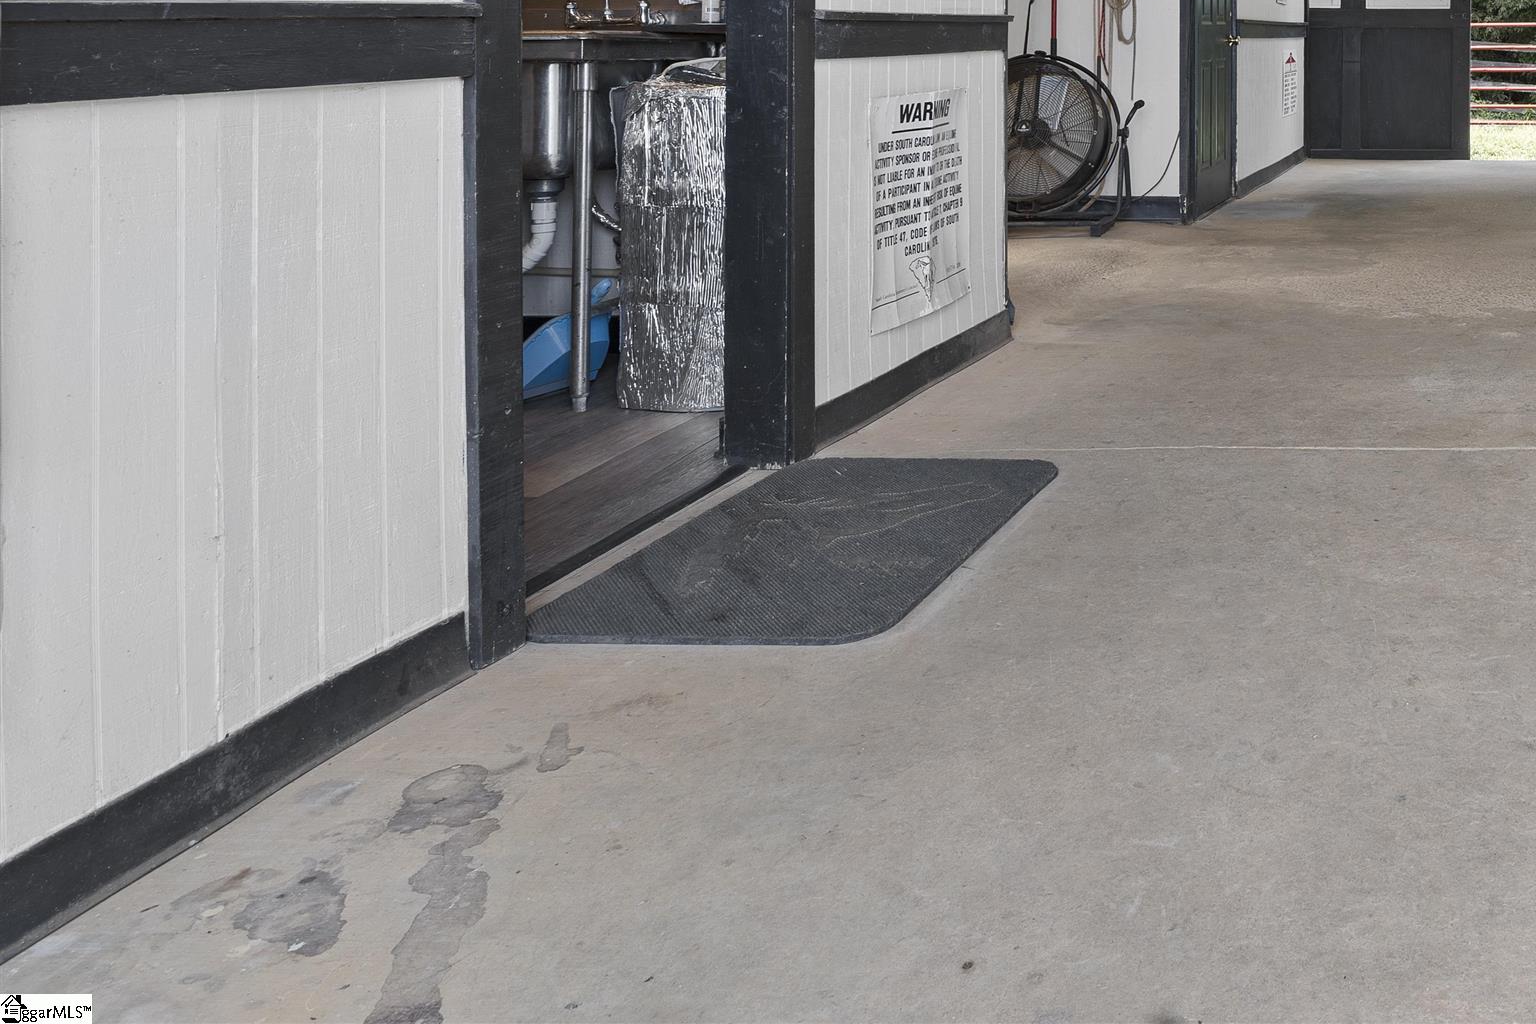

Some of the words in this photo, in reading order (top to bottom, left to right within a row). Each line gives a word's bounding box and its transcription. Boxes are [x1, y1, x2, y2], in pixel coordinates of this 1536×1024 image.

[899, 98, 951, 124] WARNING
[878, 140, 894, 153] UNDER
[895, 138, 913, 150] SOUTH
[895, 153, 920, 165] SPONSOR
[922, 151, 931, 162] OR
[876, 190, 882, 202] OF
[887, 182, 921, 198] PARTICIPANT
[923, 181, 930, 192] IN
[943, 170, 959, 183] ACTIVITY
[887, 169, 902, 183] LIABLE
[904, 168, 915, 179] FOR
[917, 166, 925, 177] AN
[896, 199, 911, 212] FROM
[912, 197, 921, 209] AN
[944, 187, 949, 197] OF
[949, 183, 962, 197] EQUINE
[895, 212, 922, 228] PURSUANT
[942, 198, 959, 213] CHAPTER
[876, 238, 883, 250] OF
[884, 233, 898, 248] TITLE
[899, 231, 908, 243] 47,
[910, 226, 928, 240] CODE
[940, 217, 945, 228] OF
[945, 212, 959, 226] SOUTH
[904, 240, 930, 257] CAROLIN
